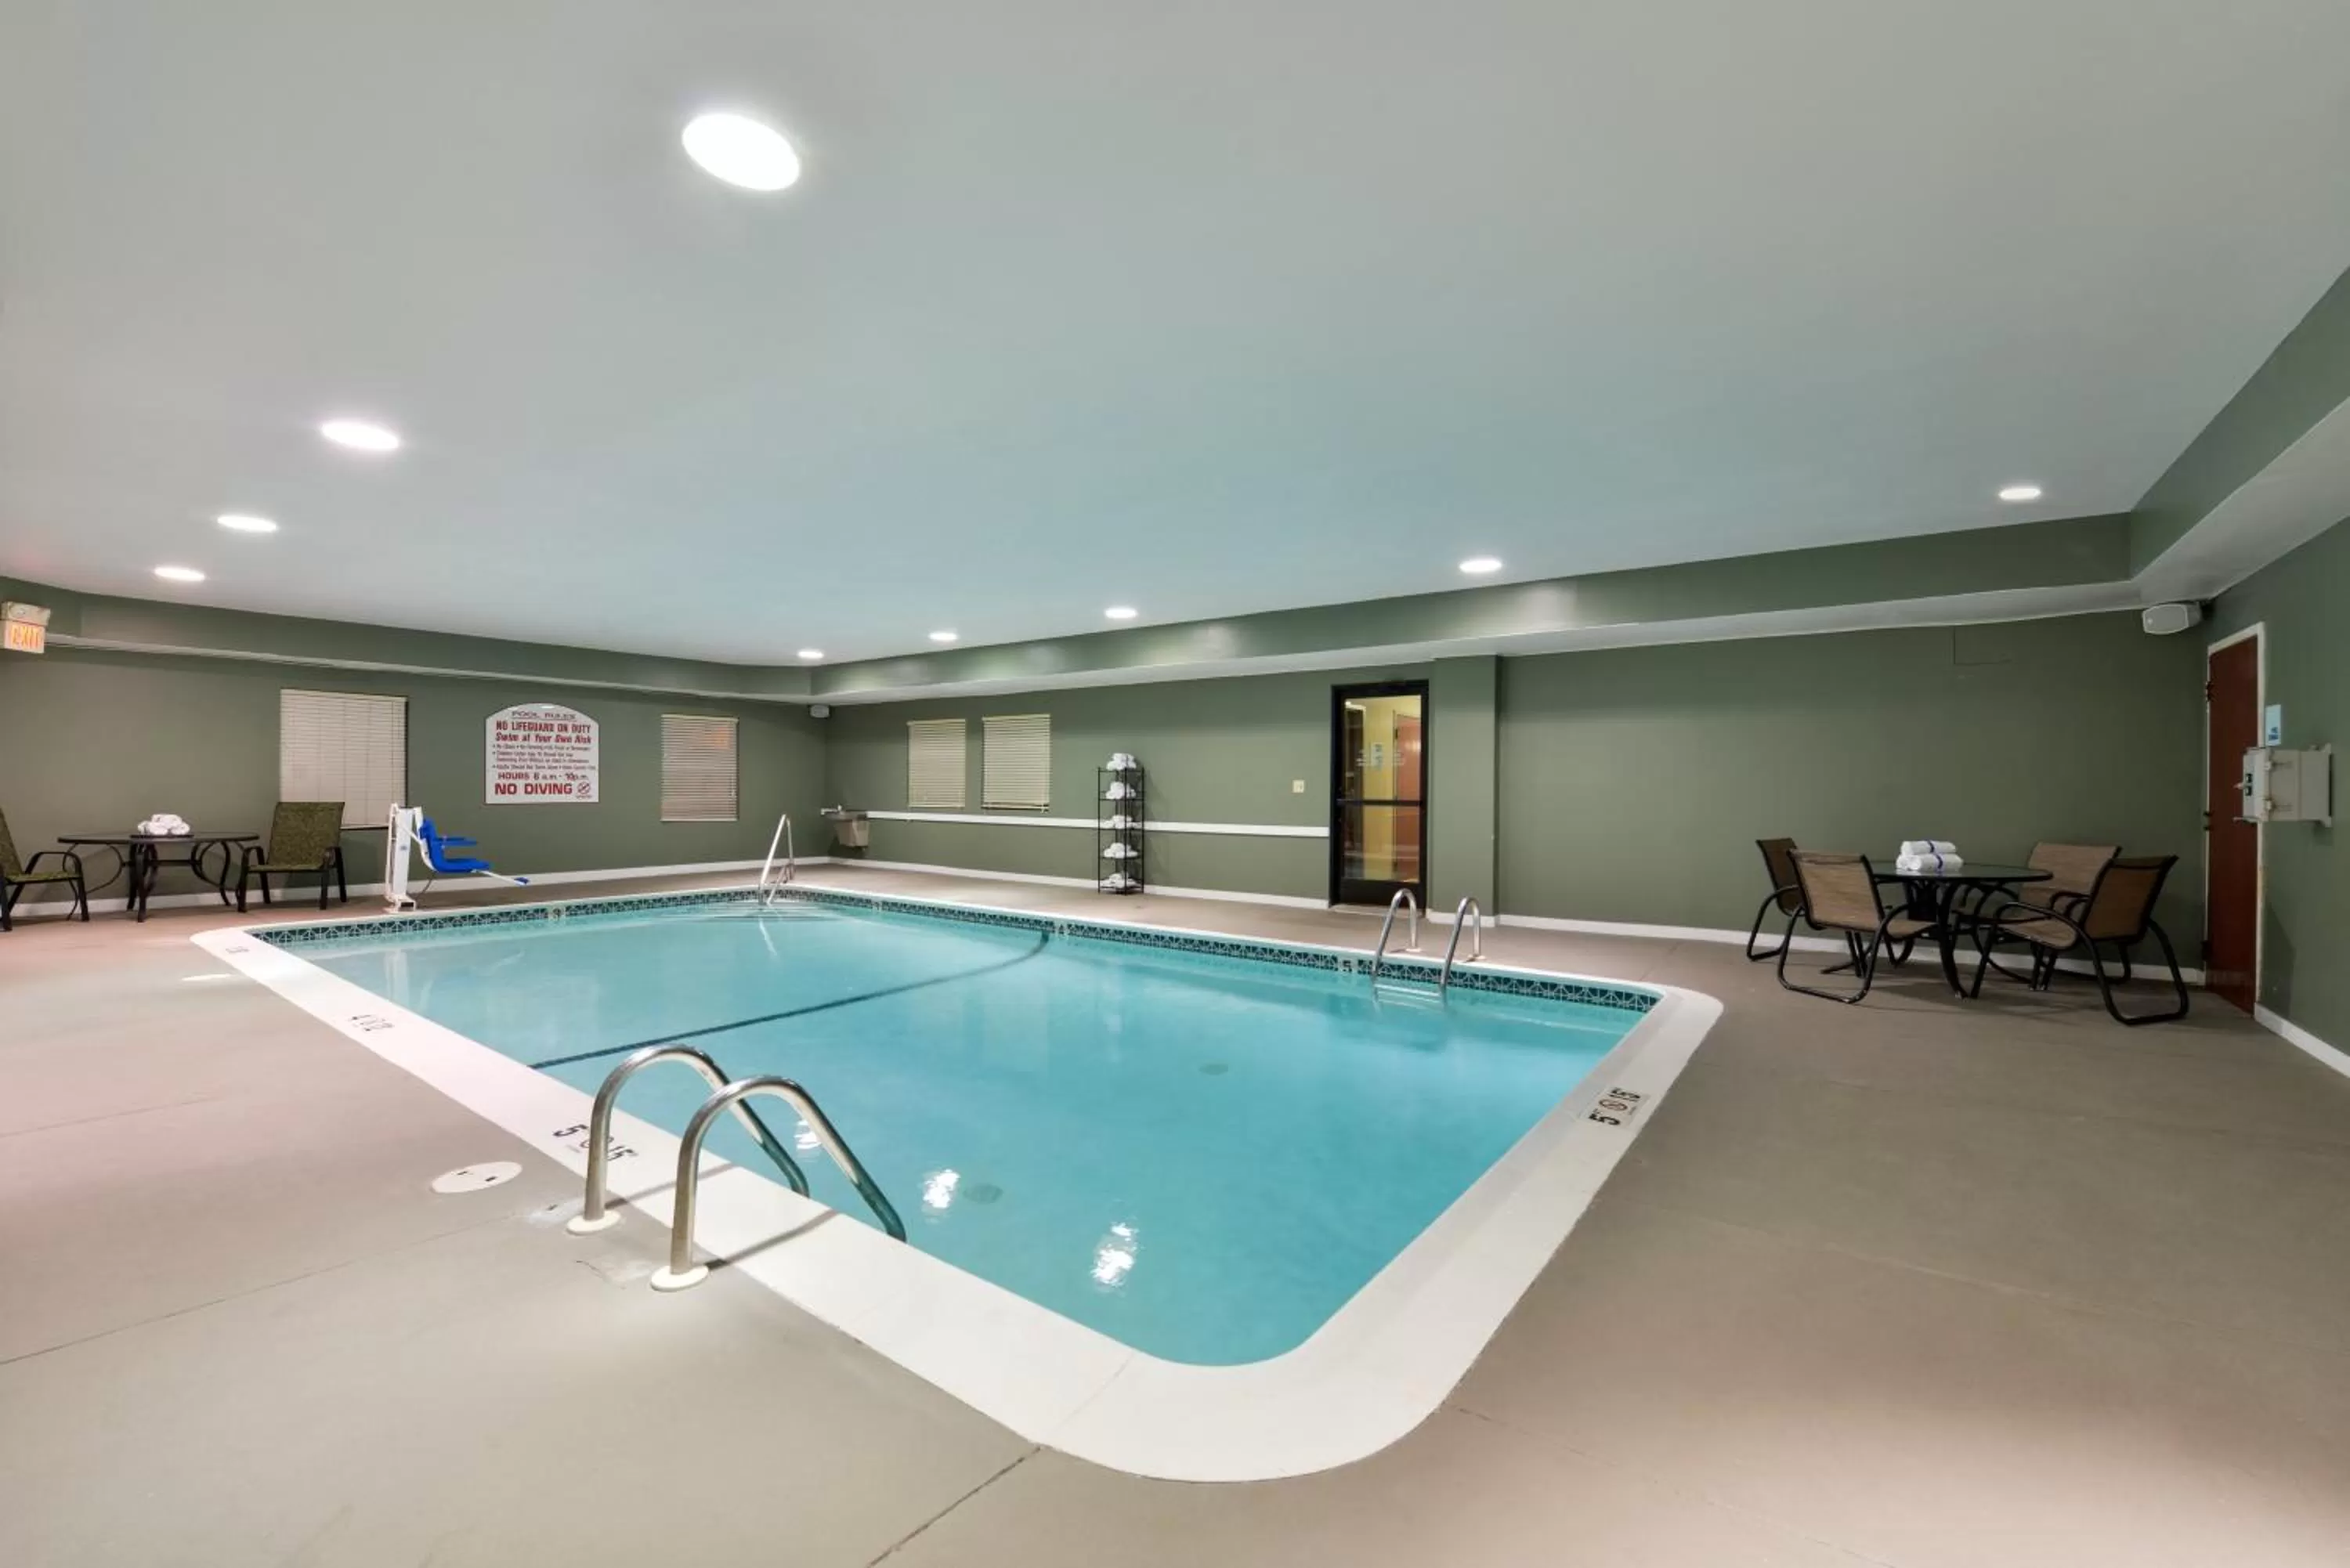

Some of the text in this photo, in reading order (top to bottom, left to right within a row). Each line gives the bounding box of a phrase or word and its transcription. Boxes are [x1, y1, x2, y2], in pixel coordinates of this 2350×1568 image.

[12, 626, 42, 649] EXIT
[496, 721, 591, 734] NO LIFEGUARD ON DUTY
[496, 732, 591, 744] Swim at Your Own Risk
[495, 783, 573, 795] NO DIVING
